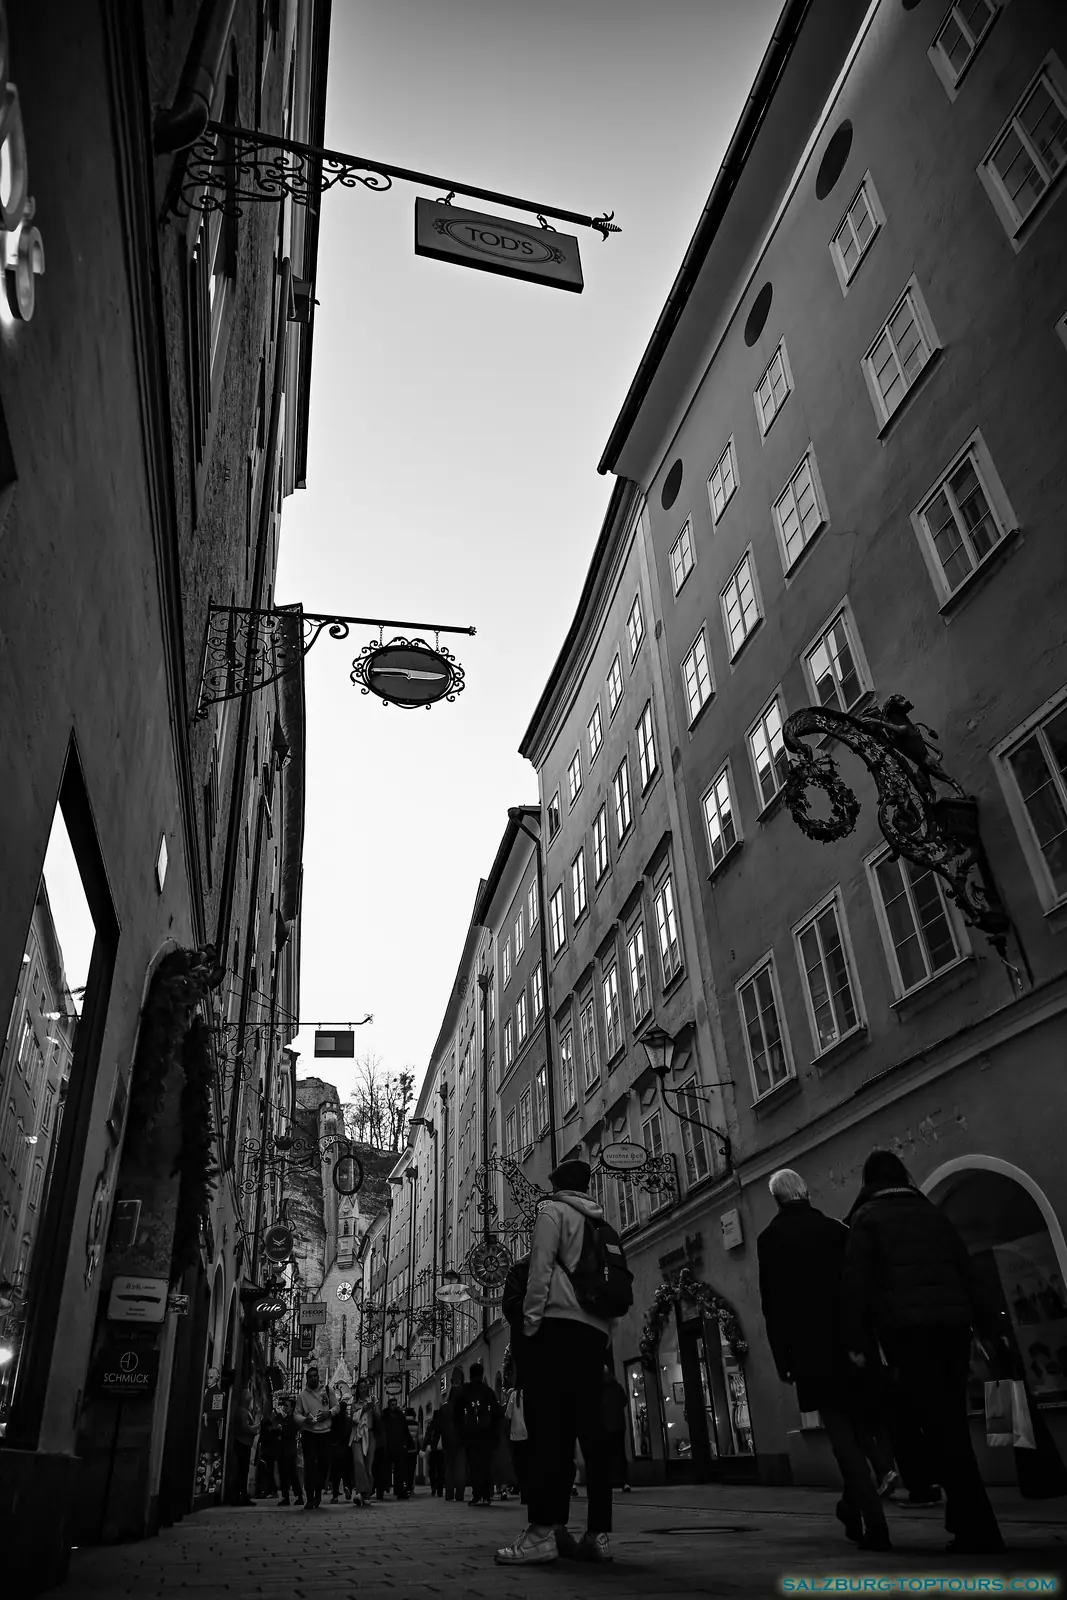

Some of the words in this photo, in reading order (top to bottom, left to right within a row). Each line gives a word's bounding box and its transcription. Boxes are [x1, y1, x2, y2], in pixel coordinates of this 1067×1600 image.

[464, 226, 534, 255] TOD'S
[256, 1302, 282, 1313] Café
[103, 1372, 149, 1384] SCHMUCK
